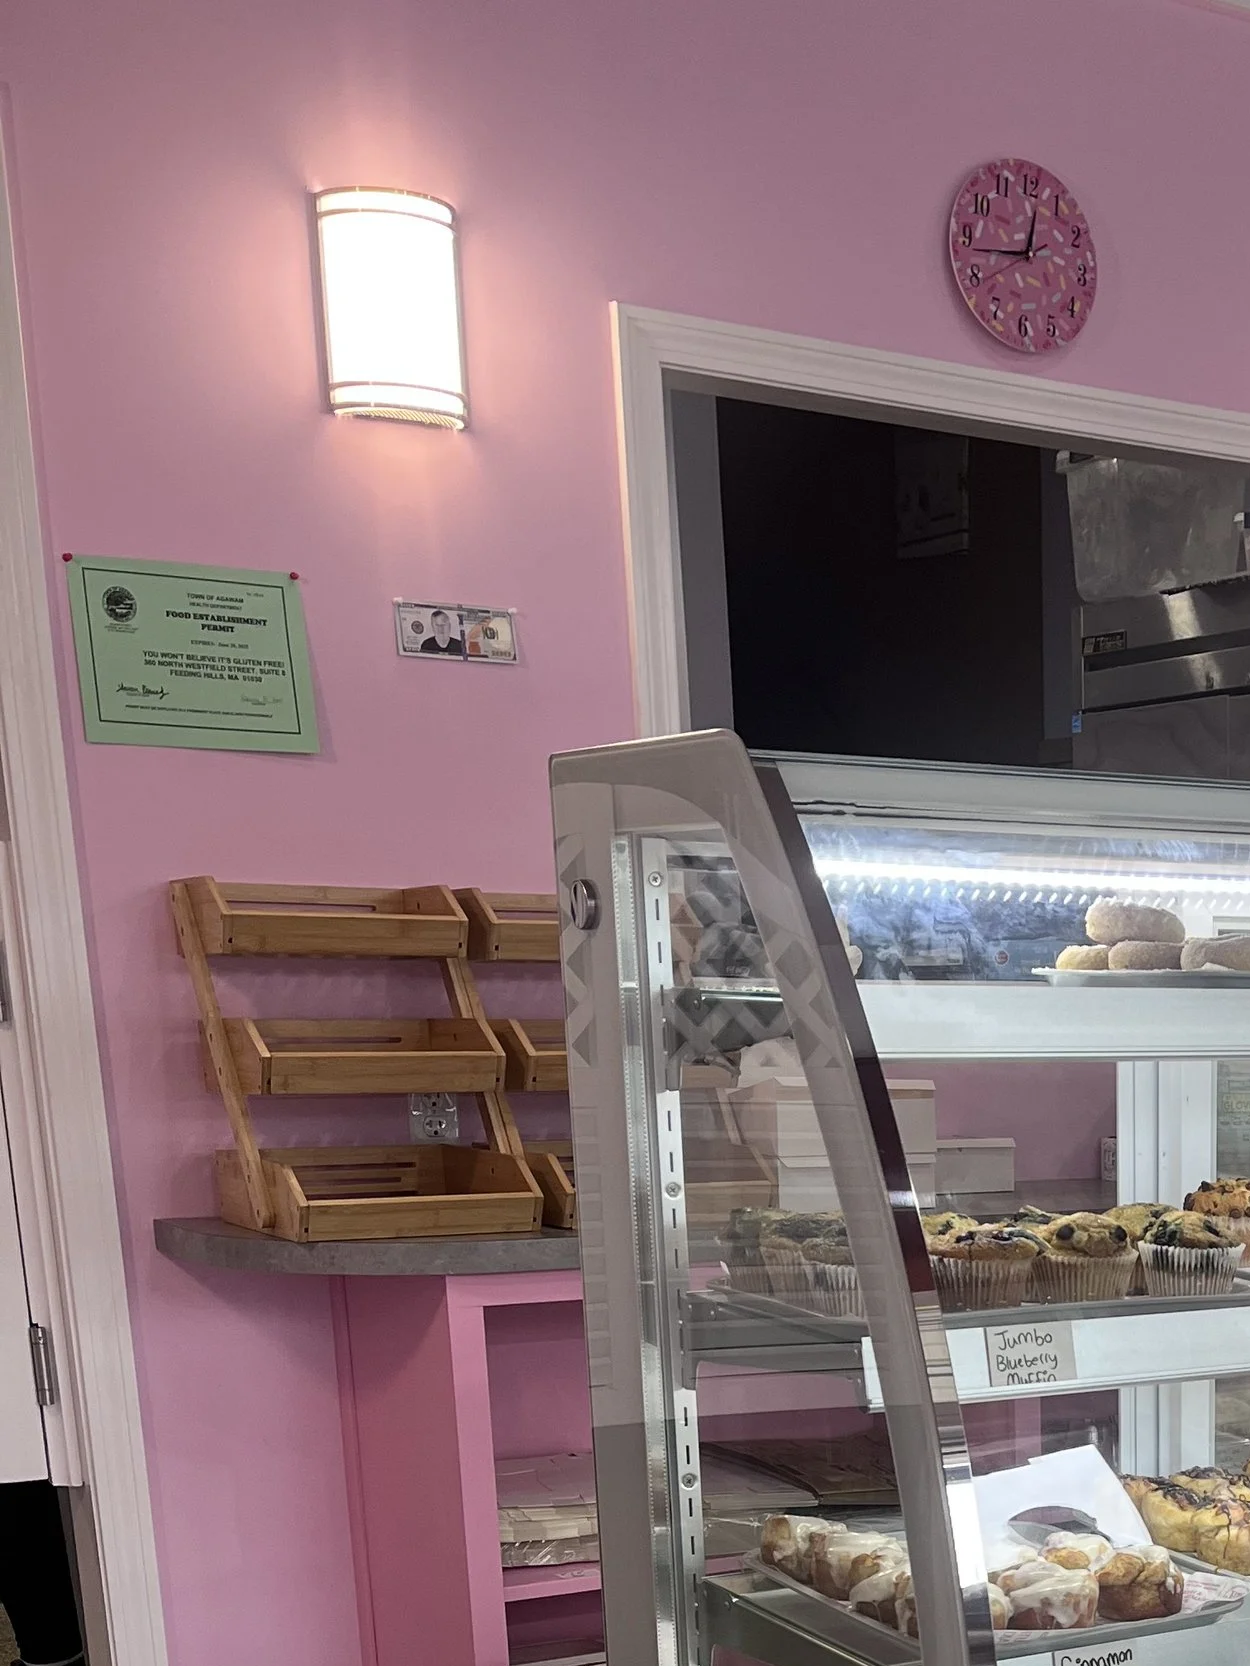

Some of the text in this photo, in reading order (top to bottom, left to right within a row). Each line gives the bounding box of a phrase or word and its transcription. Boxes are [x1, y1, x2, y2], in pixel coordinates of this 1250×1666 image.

[994, 173, 1010, 198] 11
[1022, 173, 1040, 199] 12
[973, 192, 990, 217] 10
[1053, 194, 1060, 217] 1
[962, 224, 973, 247] 9
[1071, 225, 1081, 249] 2
[970, 264, 981, 288] 8
[1077, 263, 1087, 287] 3
[991, 296, 1001, 320] 7
[1067, 296, 1077, 318] 4
[1018, 314, 1029, 338] 6
[1046, 314, 1057, 338] 5
[165, 611, 268, 626] FOOD ESTABLISHMENT
[201, 623, 235, 633] PERMIT
[142, 650, 159, 659] YOU
[160, 652, 184, 660] WON'T
[186, 654, 217, 663] BELIEVE
[233, 658, 262, 667] GLUTEN
[157, 660, 184, 668] NORTH
[185, 662, 227, 672] WESTFIELD
[169, 669, 202, 678] FEEDING
[227, 673, 240, 681] MA
[993, 1328, 1054, 1352] Jumbo
[995, 1353, 1059, 1373] Blueberry
